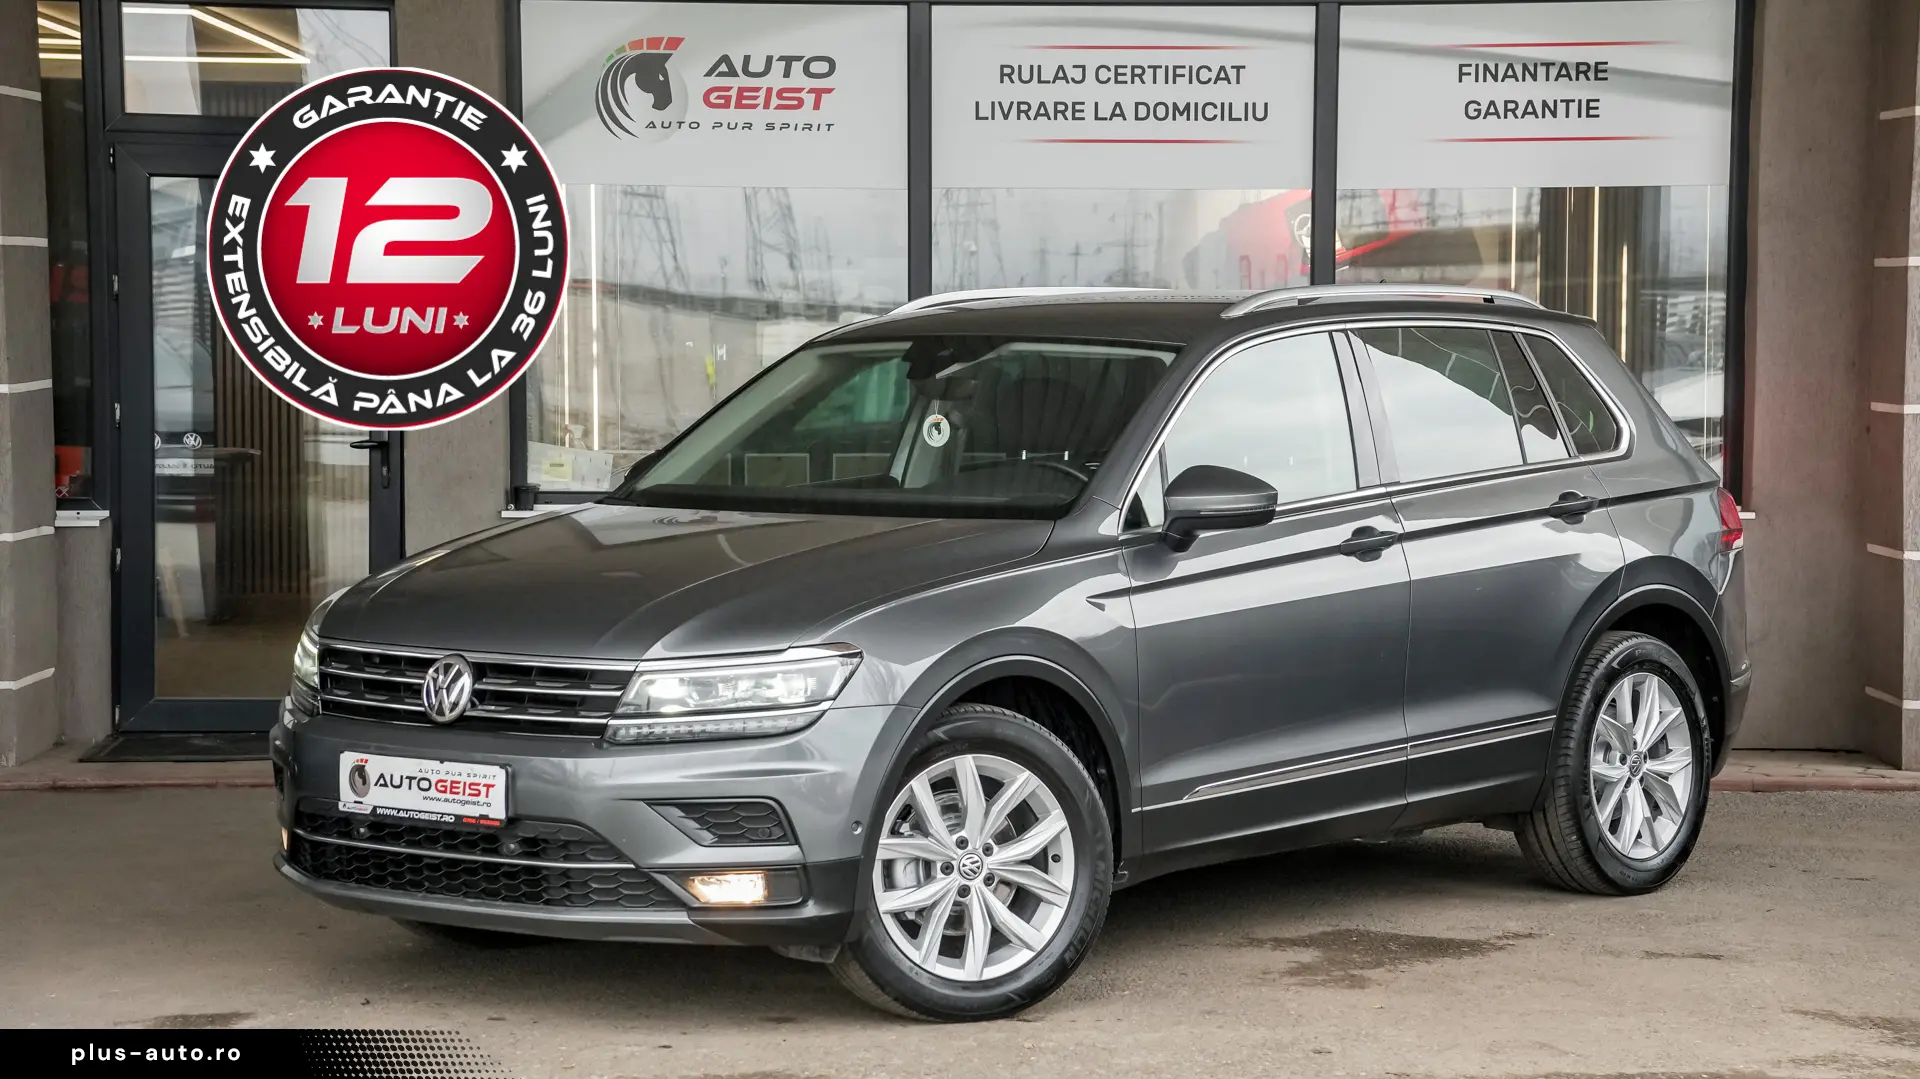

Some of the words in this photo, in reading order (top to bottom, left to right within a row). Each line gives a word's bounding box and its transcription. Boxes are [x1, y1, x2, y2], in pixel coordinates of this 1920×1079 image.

[703, 53, 837, 79] AUTO
[999, 64, 1086, 84] RULAJ
[1094, 64, 1246, 85] CERTIFICAT
[1458, 61, 1609, 83] FINANTARE
[702, 86, 837, 110] GEIST
[975, 101, 1086, 121] LIVRARE
[1094, 102, 1127, 121] LA
[1134, 102, 1269, 122] DOMICILIU
[1464, 98, 1601, 120] GARANTIE
[644, 120, 701, 129] AUTO
[711, 121, 753, 131] PUR
[764, 122, 836, 131] SPIRIT
[466, 773, 497, 781] SPIRIT
[422, 795, 492, 808] www.autogeist.ro
[376, 807, 456, 823] WWW.AUTOGEIST.RO
